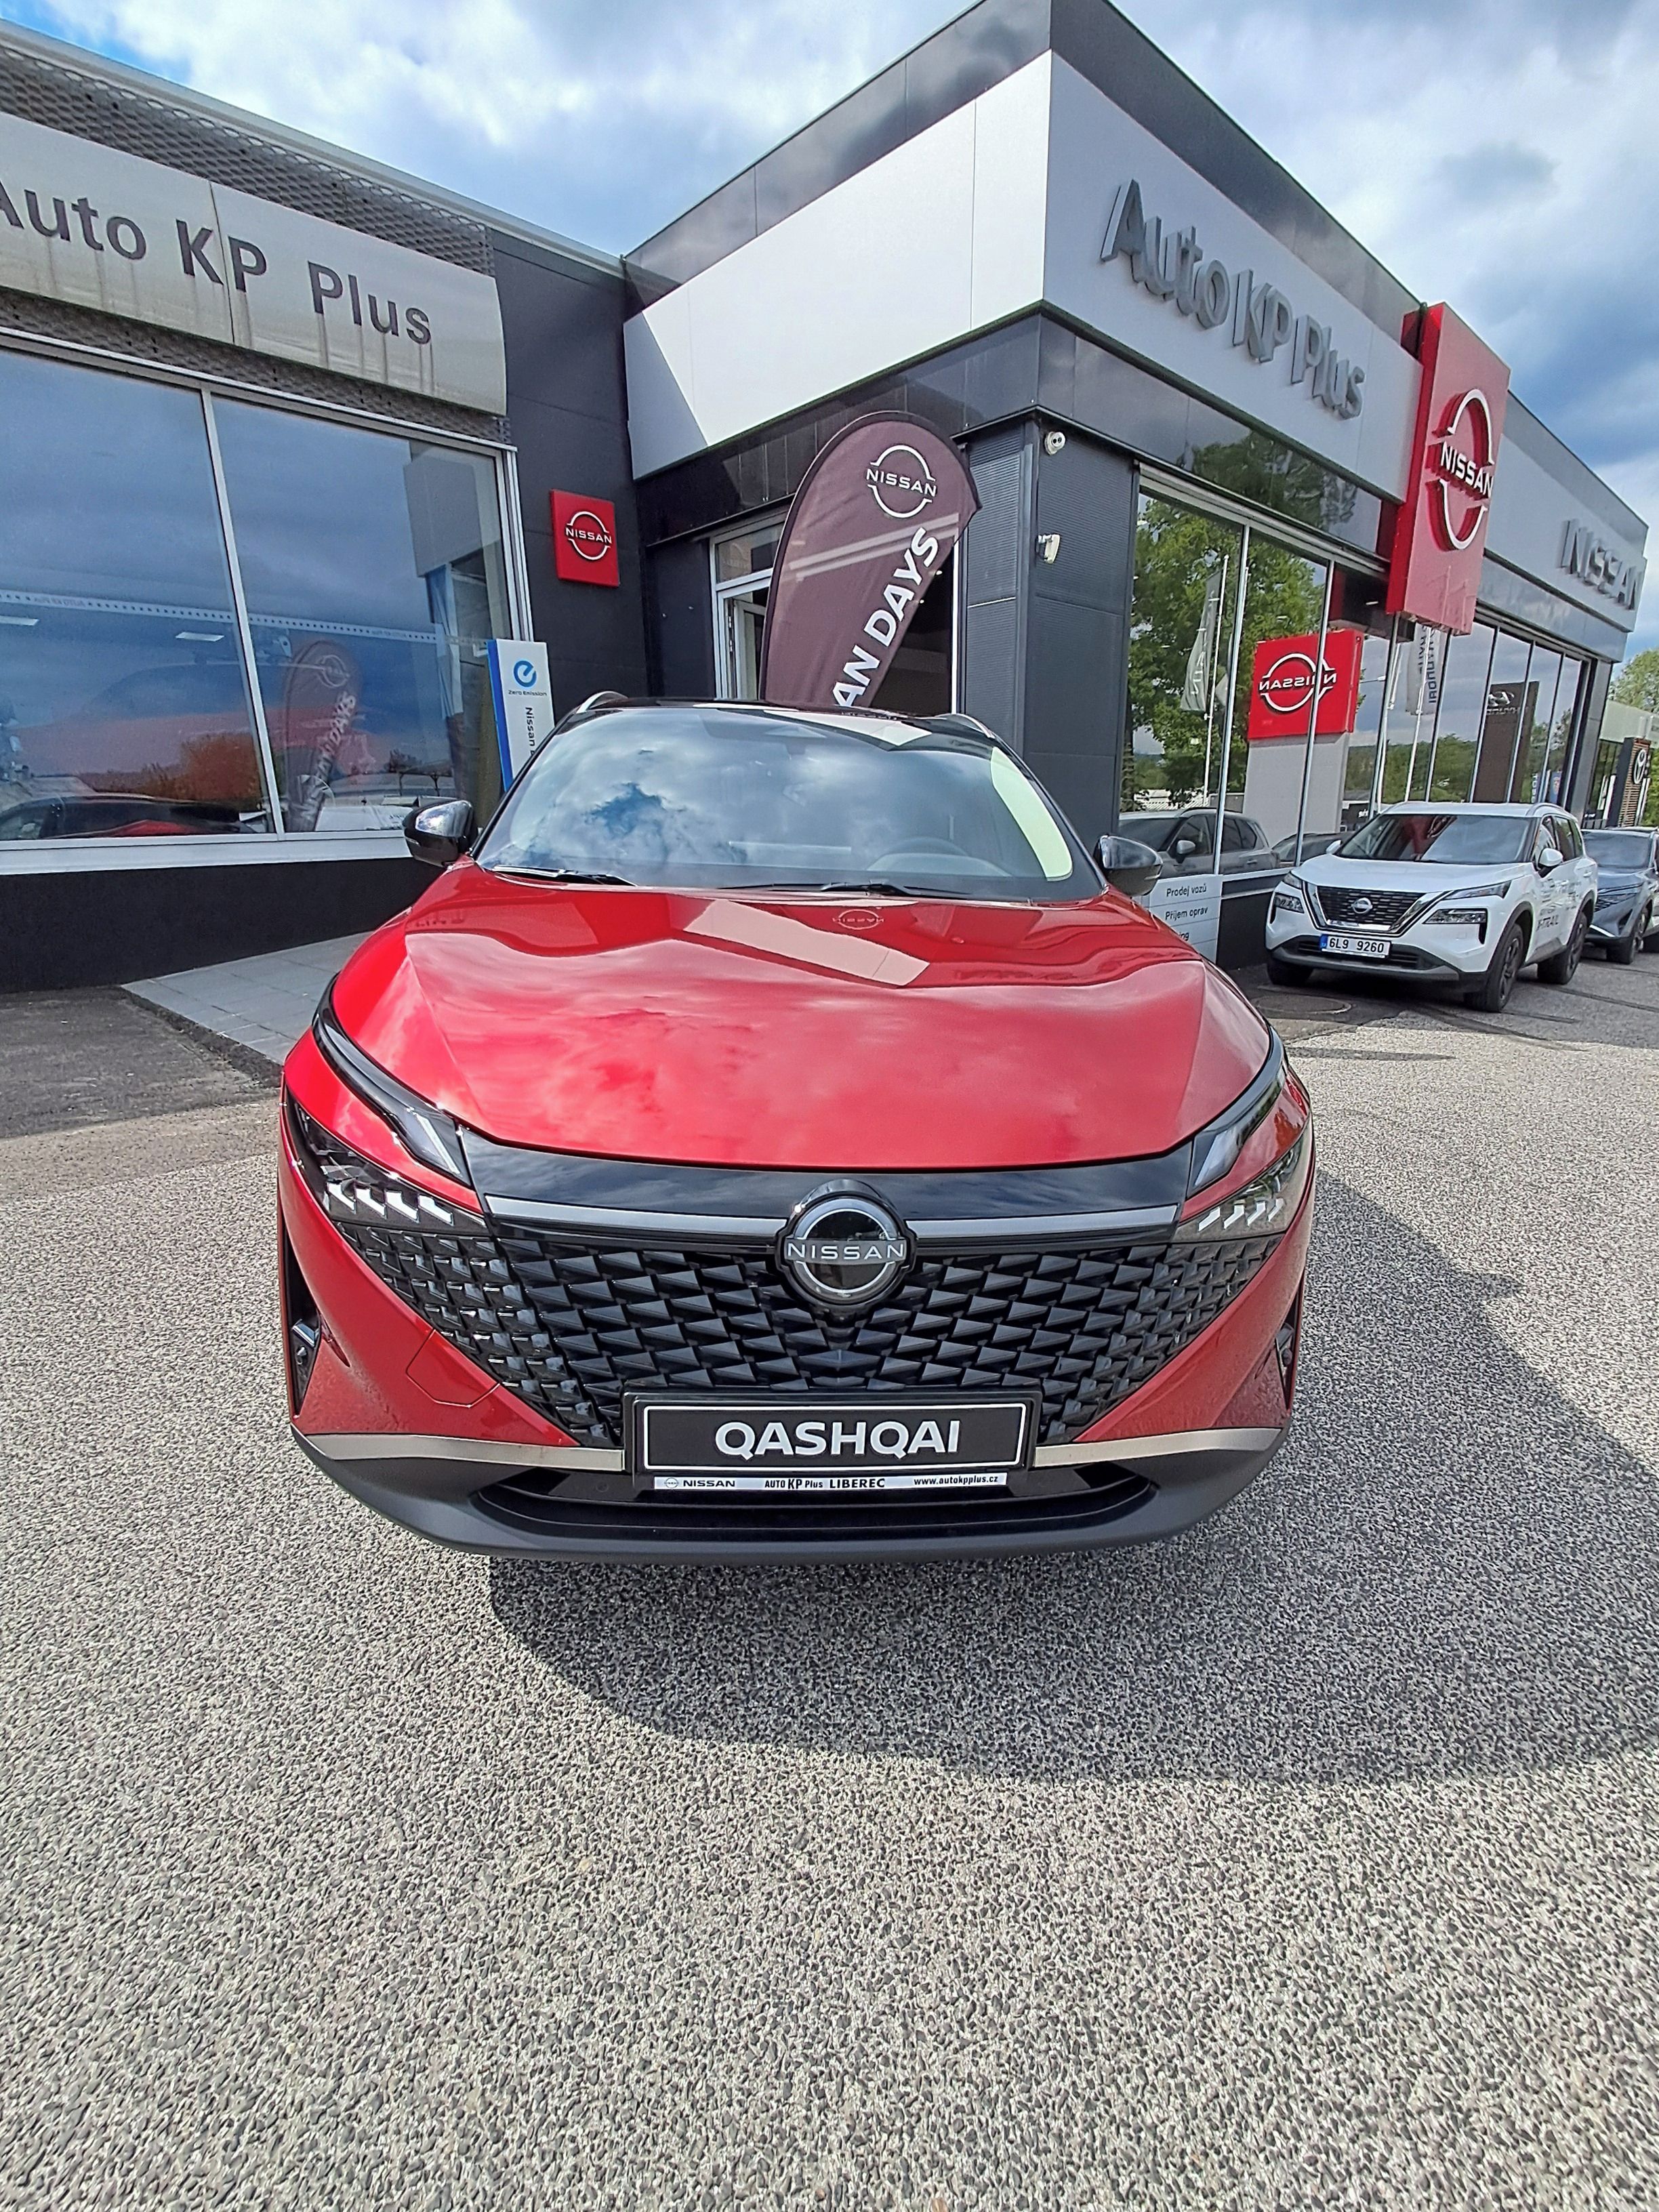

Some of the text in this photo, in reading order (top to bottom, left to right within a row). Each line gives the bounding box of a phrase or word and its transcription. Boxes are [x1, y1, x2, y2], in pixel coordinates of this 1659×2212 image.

[176, 218, 267, 293] KP
[308, 260, 432, 344] Plus
[1100, 179, 1366, 420] Auto KP Plus
[1440, 441, 1494, 498] NISSAN
[866, 468, 937, 497] NISSAN
[565, 527, 613, 544] NISSAN
[1557, 518, 1643, 611] NISSAN
[863, 527, 939, 647] DAYS
[525, 706, 535, 747] Nissan
[1166, 883, 1207, 897] Prodej vozů
[1189, 907, 1208, 918] oprav
[1329, 937, 1385, 953] 6L9 9260
[787, 1242, 905, 1260] NISSAN
[715, 1420, 961, 1460] QASHQAI
[682, 1479, 736, 1488] NISSAN
[764, 1478, 886, 1490] AUTO KP Plus LIBEREC
[914, 1475, 999, 1486] www.autokpplus.cz
